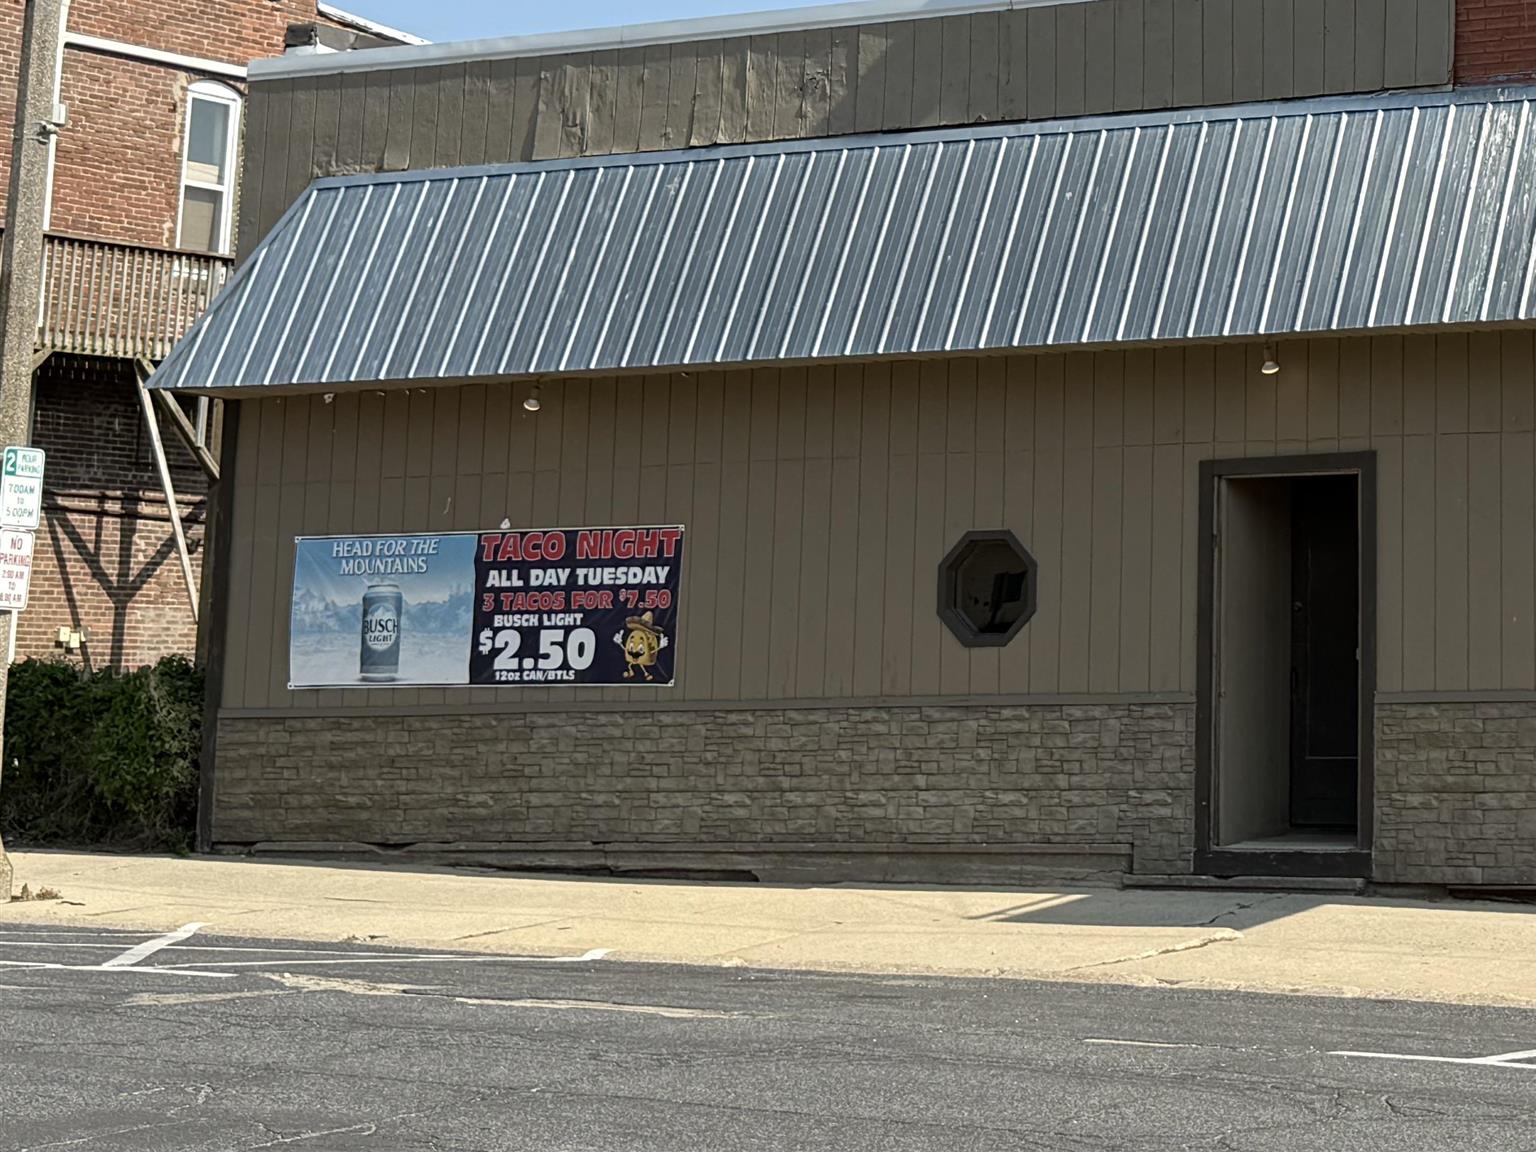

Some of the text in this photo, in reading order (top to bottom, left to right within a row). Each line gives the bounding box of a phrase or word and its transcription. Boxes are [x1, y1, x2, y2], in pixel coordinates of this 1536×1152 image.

[6, 452, 16, 472] 2
[10, 536, 23, 550] NO
[332, 538, 440, 558] HEAD FOR THE
[481, 528, 682, 561] TACO NIGHT
[340, 556, 428, 575] MOUNTAINS
[486, 566, 670, 587] ALL DAY TUESDAY
[482, 588, 672, 612] 3 TACOS FOR $7.50
[364, 618, 399, 635] BUSCH
[493, 613, 583, 627] BUSCH LIGHT
[368, 634, 393, 643] LIGHT
[478, 627, 596, 671] $2.50
[495, 670, 576, 681] 12oz CAN/BTLS
